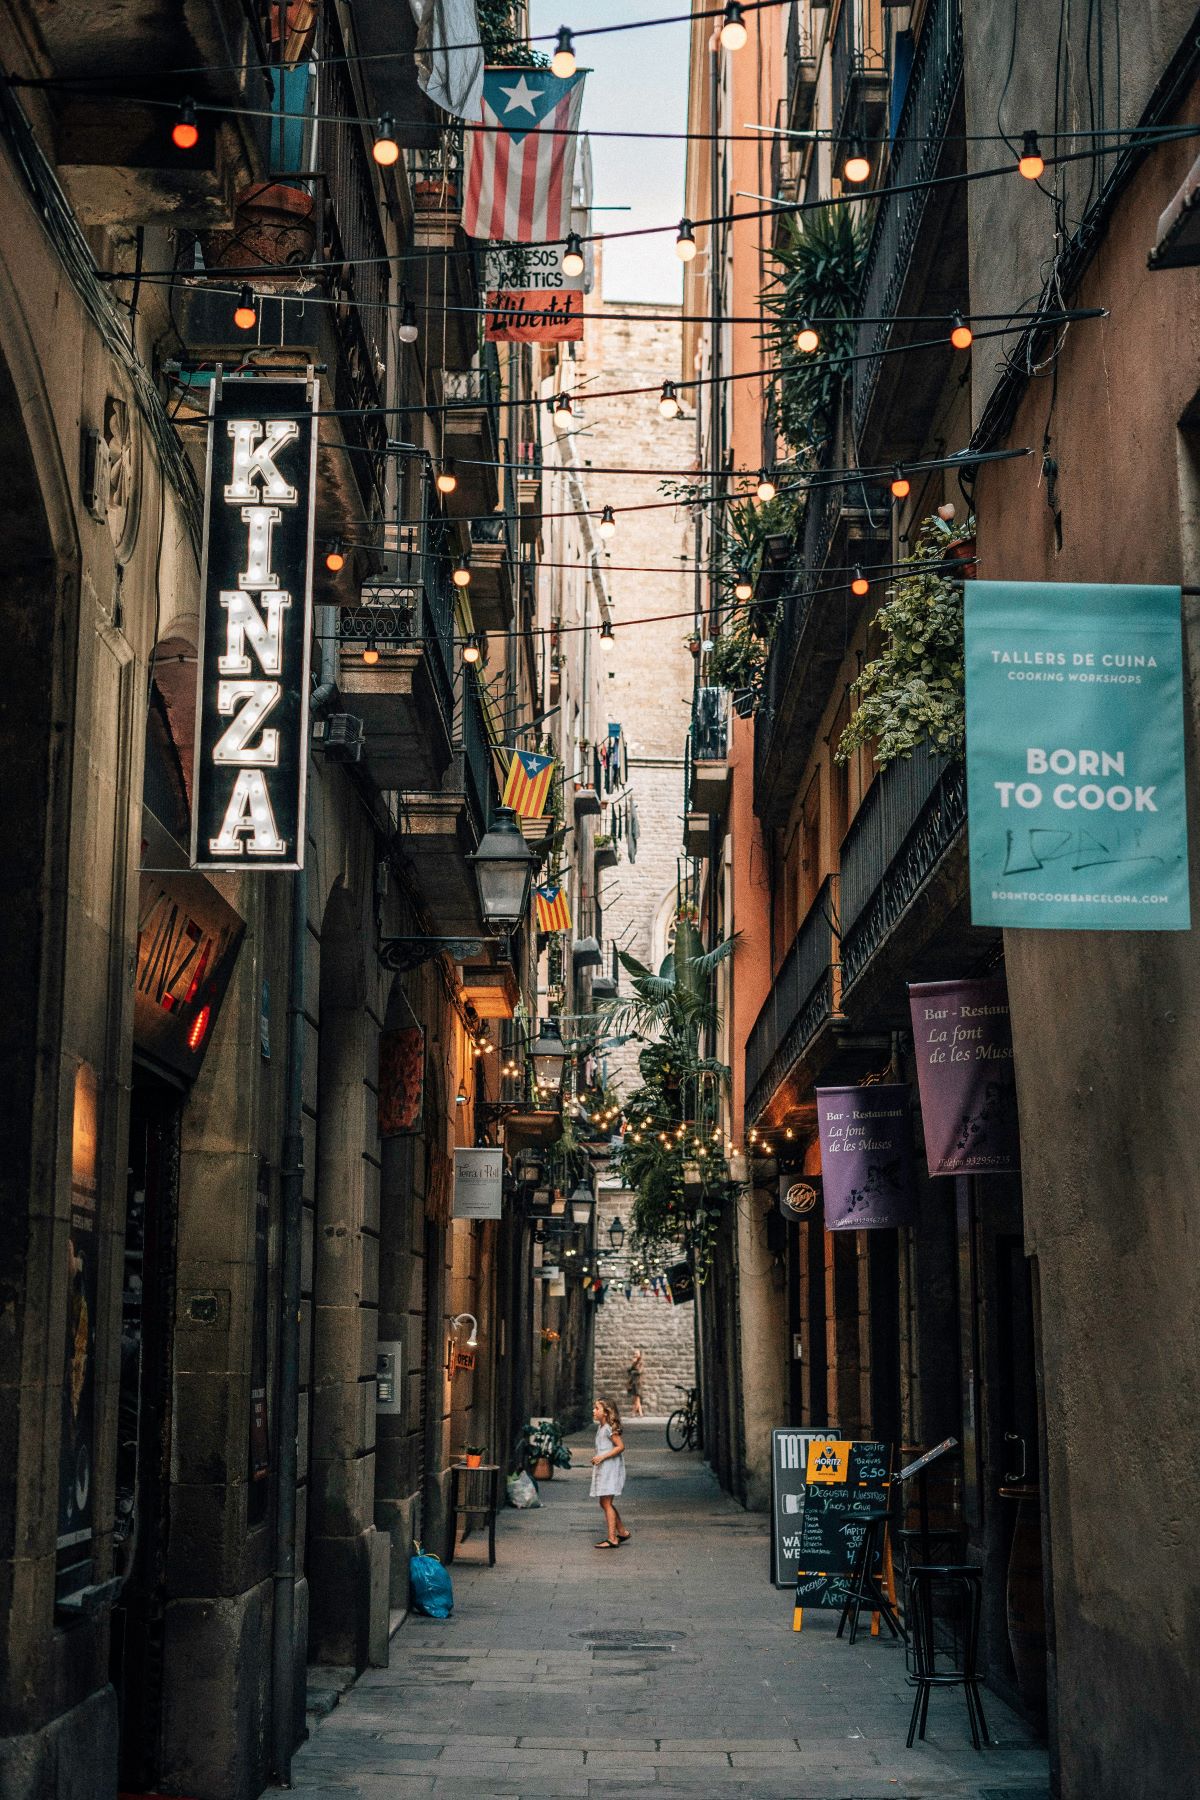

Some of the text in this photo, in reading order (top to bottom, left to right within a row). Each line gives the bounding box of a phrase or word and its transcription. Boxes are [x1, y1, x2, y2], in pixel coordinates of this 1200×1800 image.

[209, 420, 299, 855] KINZA
[991, 650, 1158, 668] TALLERS DE CUINA
[1007, 671, 1142, 684] COOKING WORKSHOPS
[1026, 747, 1126, 777] BORN
[994, 781, 1159, 812] TO COOK
[991, 890, 1169, 904] BORNTOCOOKBARCELONA.COM
[924, 1008, 949, 1020] Bar
[926, 1025, 984, 1047] La font
[929, 1048, 946, 1064] de
[950, 1046, 971, 1062] les
[826, 1112, 844, 1121] Bar
[852, 1109, 903, 1119] Restaurant
[828, 1124, 866, 1140] La font
[829, 1140, 841, 1152] de
[843, 1139, 856, 1151] les
[457, 1353, 473, 1367] OPEN
[815, 1458, 842, 1466] MORITZ
[860, 1466, 886, 1478] 6.50
